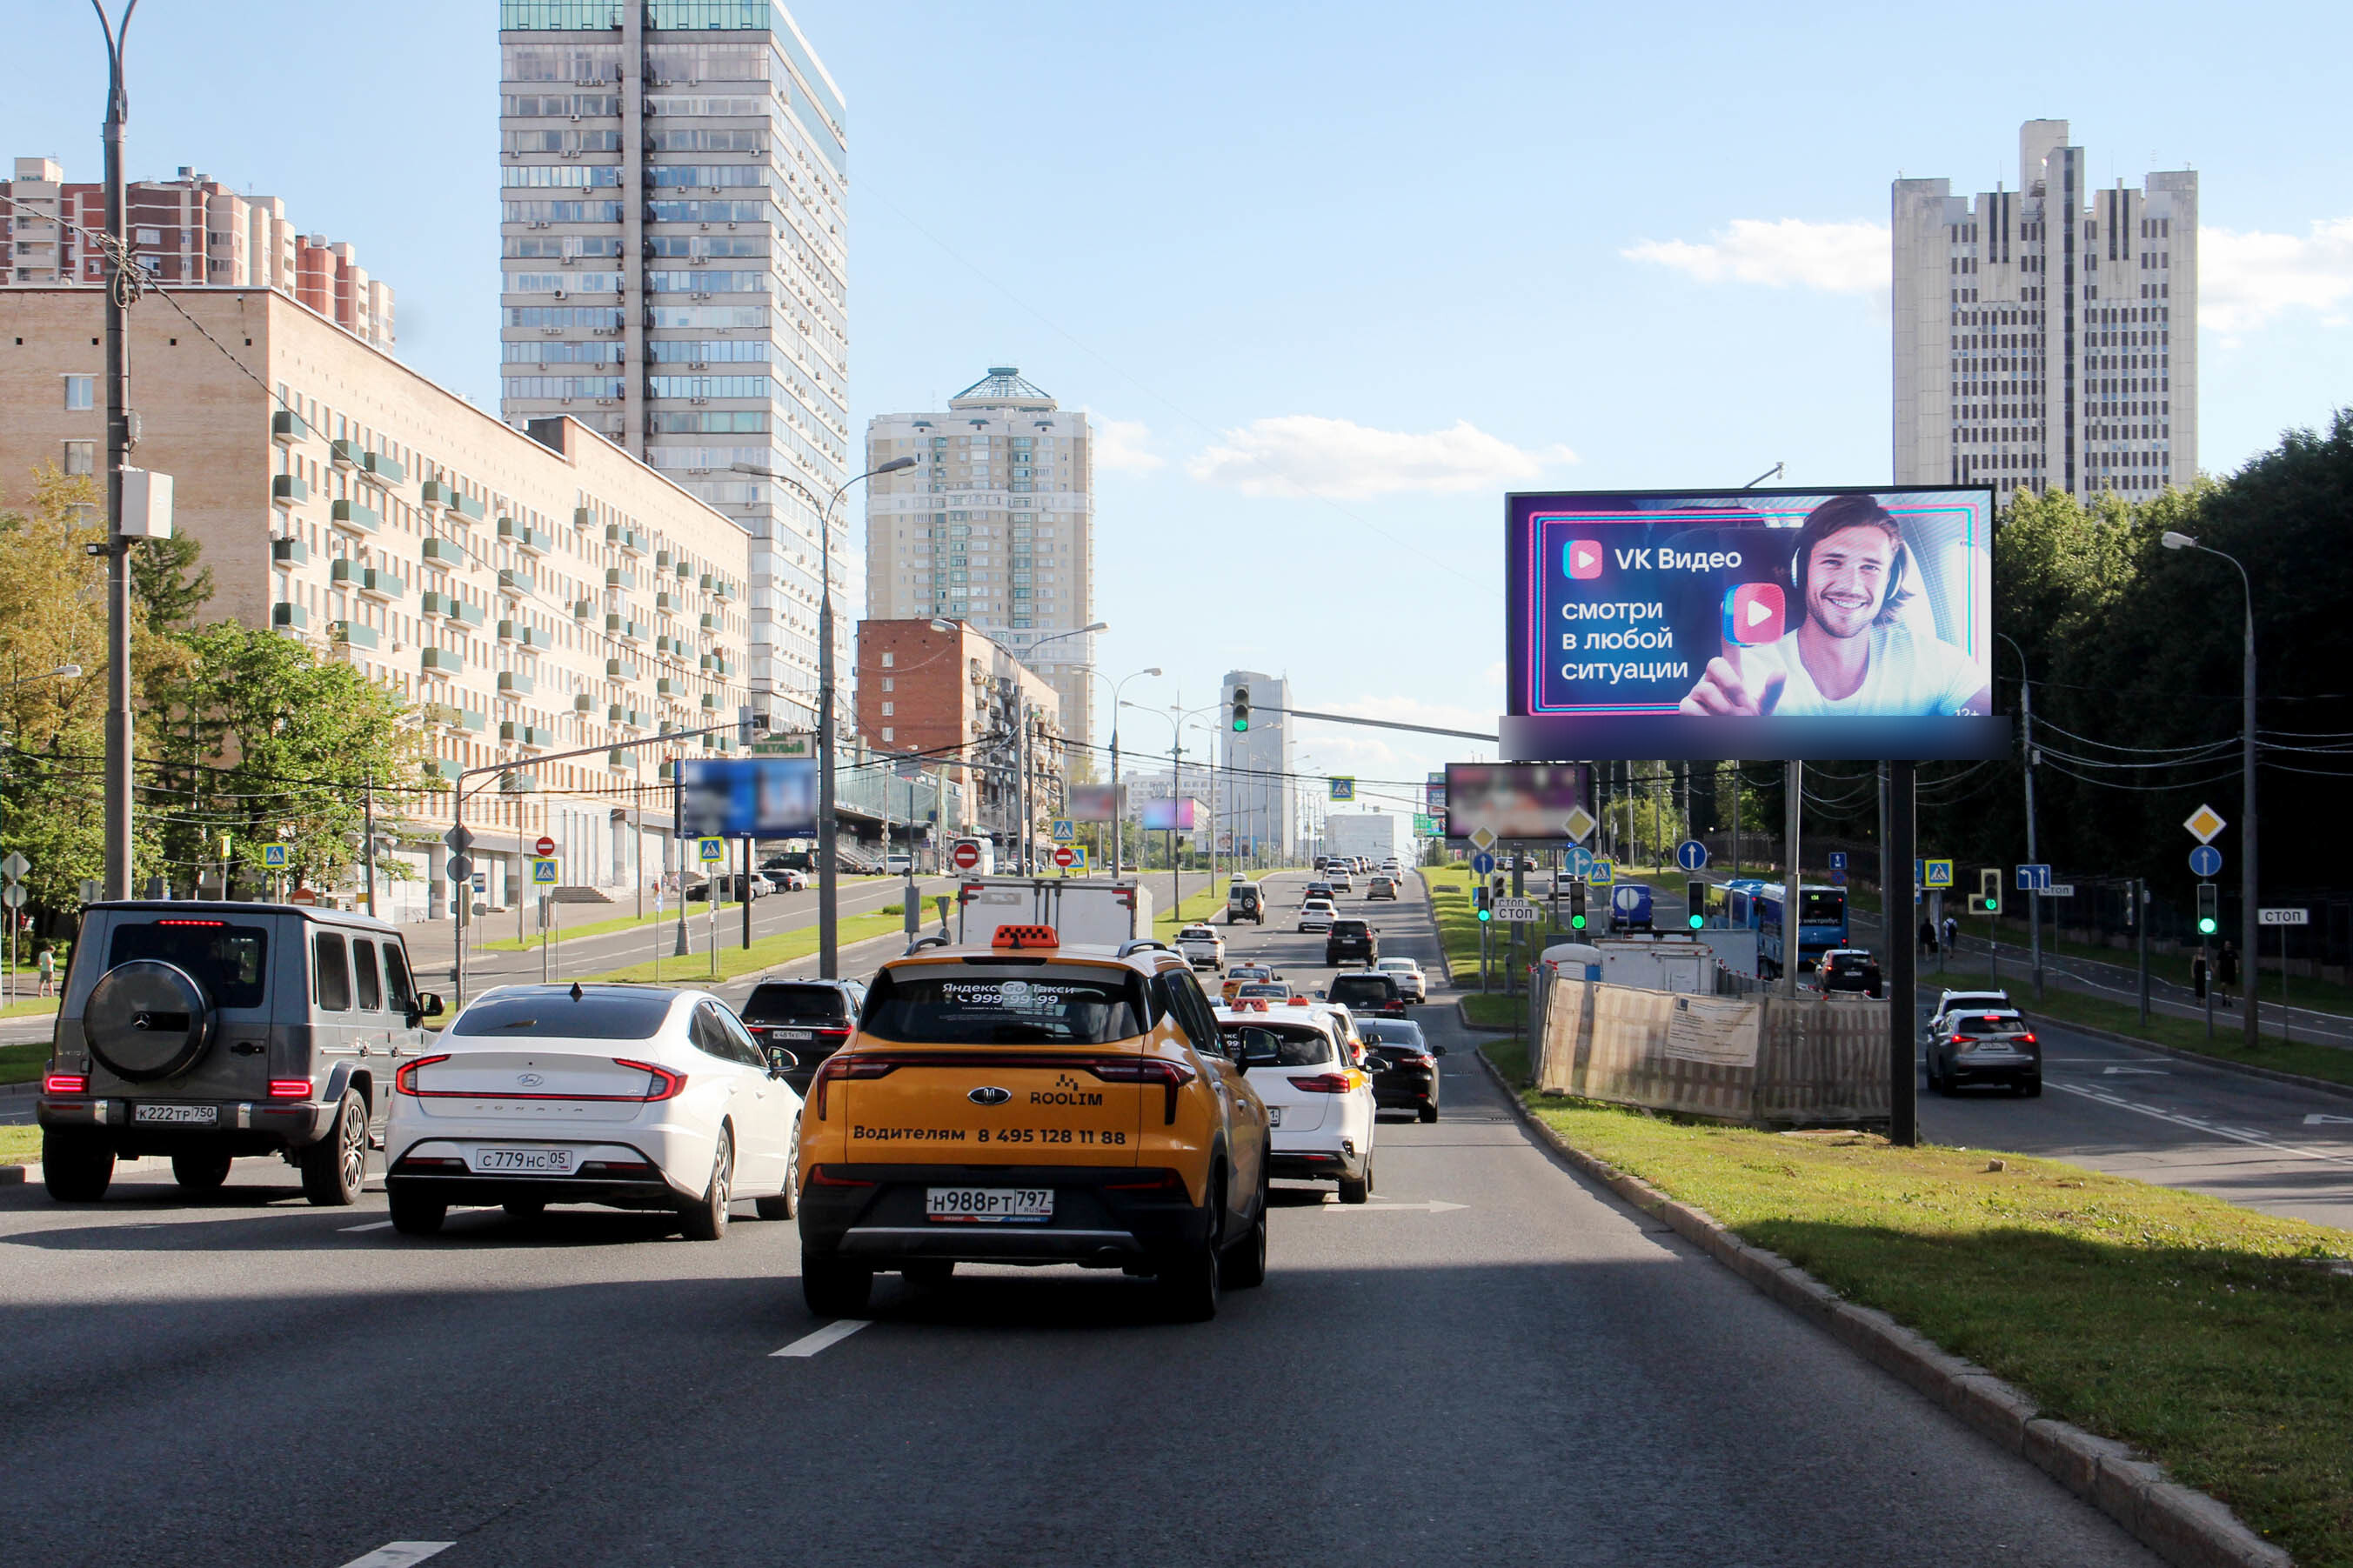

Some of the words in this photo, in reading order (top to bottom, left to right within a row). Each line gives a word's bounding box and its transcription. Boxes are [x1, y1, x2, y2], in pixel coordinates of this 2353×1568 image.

[1614, 548, 1652, 570] VK
[1658, 548, 1742, 573] Видео
[1561, 602, 1663, 624] смотри
[1562, 633, 1577, 650] в
[1584, 626, 1673, 650] любой
[1561, 661, 1688, 685] ситуации
[1499, 908, 1533, 919] СТОП
[2265, 911, 2301, 922] СТОП
[942, 983, 998, 994] Яндекс
[1003, 983, 1026, 993] Go
[1032, 984, 1075, 994] Такси
[972, 994, 1059, 1004] 999-99-99
[1030, 1091, 1102, 1106] ROOLIM
[193, 1106, 214, 1118] 750
[853, 1124, 966, 1142] Водителям
[978, 1129, 990, 1143] 8
[996, 1129, 1034, 1143] 495
[1039, 1129, 1073, 1144] 128
[1078, 1130, 1094, 1144] 11
[1100, 1131, 1126, 1144] 88
[550, 1152, 565, 1164] 05
[1016, 1191, 1047, 1207] 797
